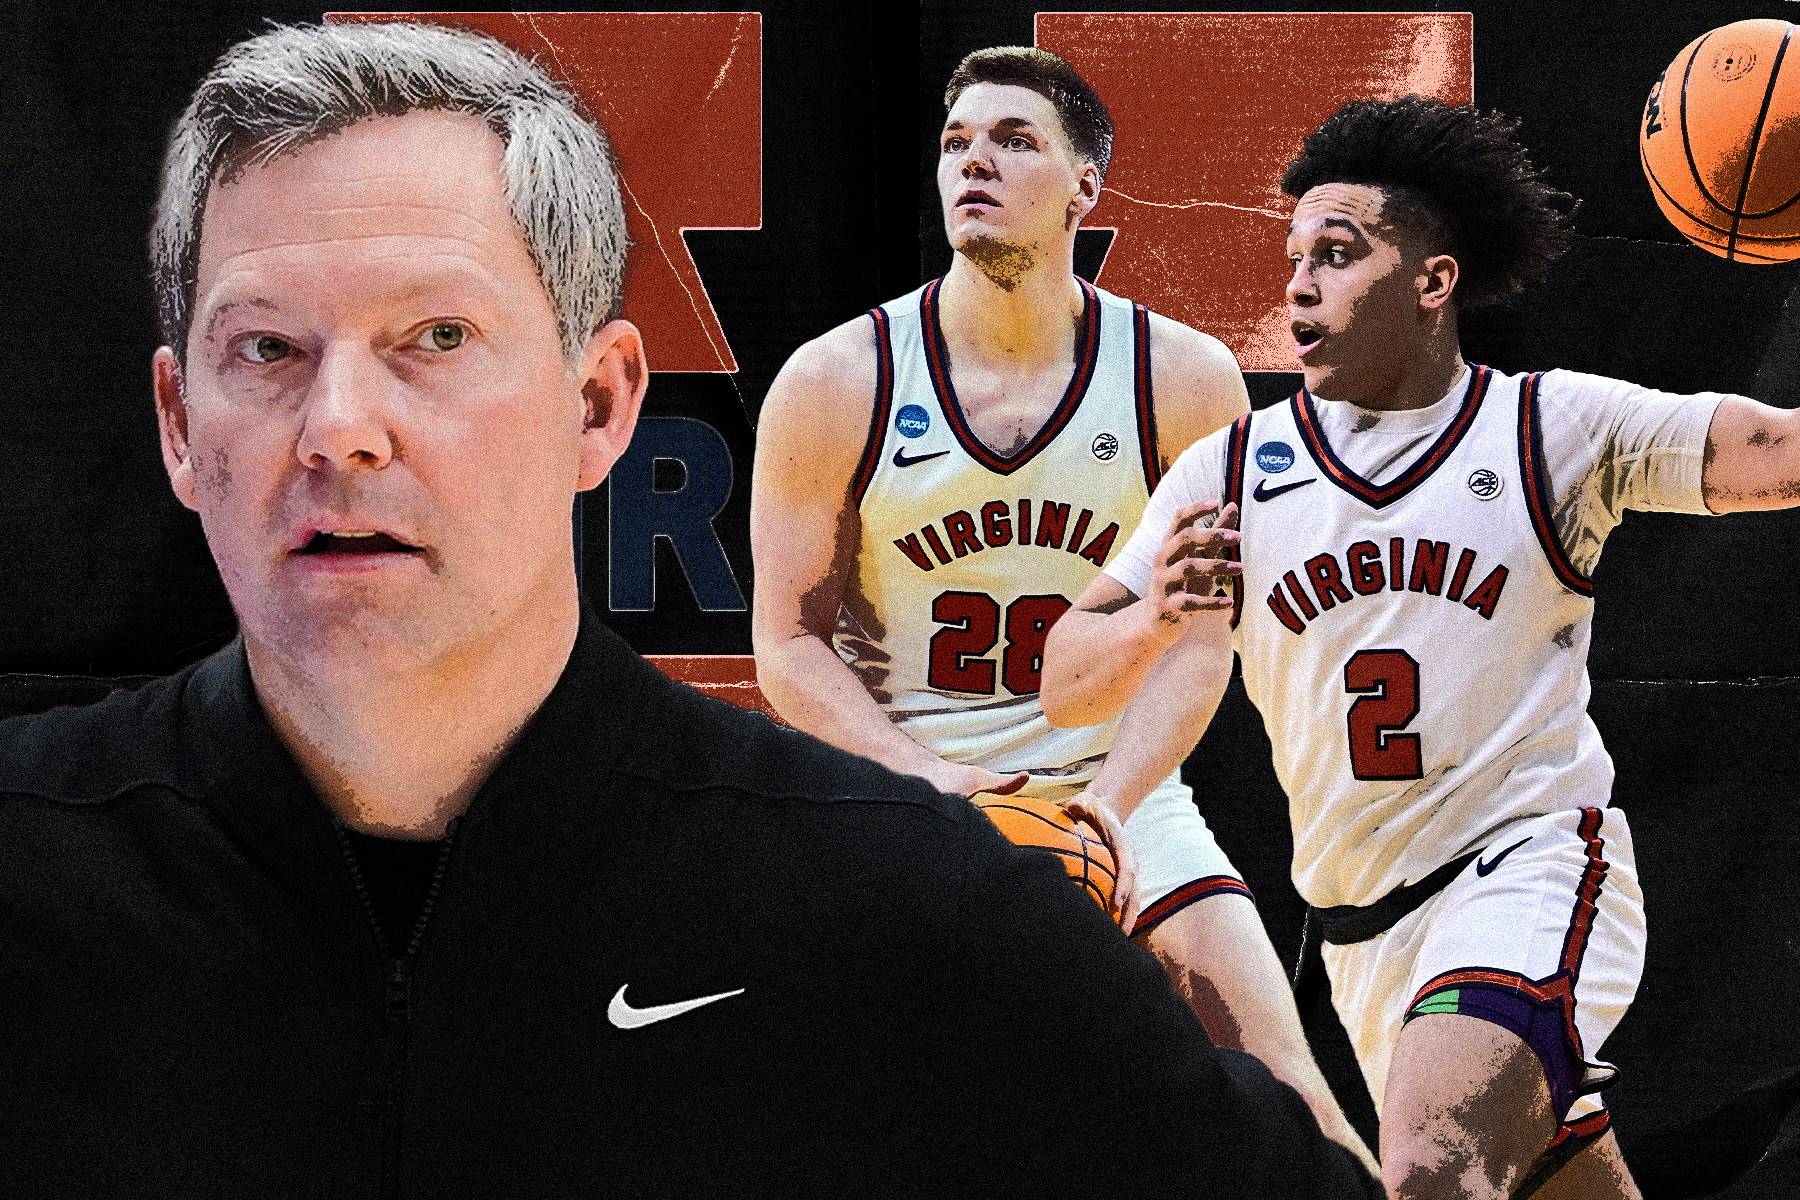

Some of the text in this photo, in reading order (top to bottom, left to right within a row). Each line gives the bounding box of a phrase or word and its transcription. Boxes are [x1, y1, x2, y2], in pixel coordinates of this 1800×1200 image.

[893, 499, 1119, 572] VIRGINIA
[1266, 537, 1509, 635] VIRGINIA
[927, 590, 1073, 696] 28
[1344, 648, 1424, 781] 2
